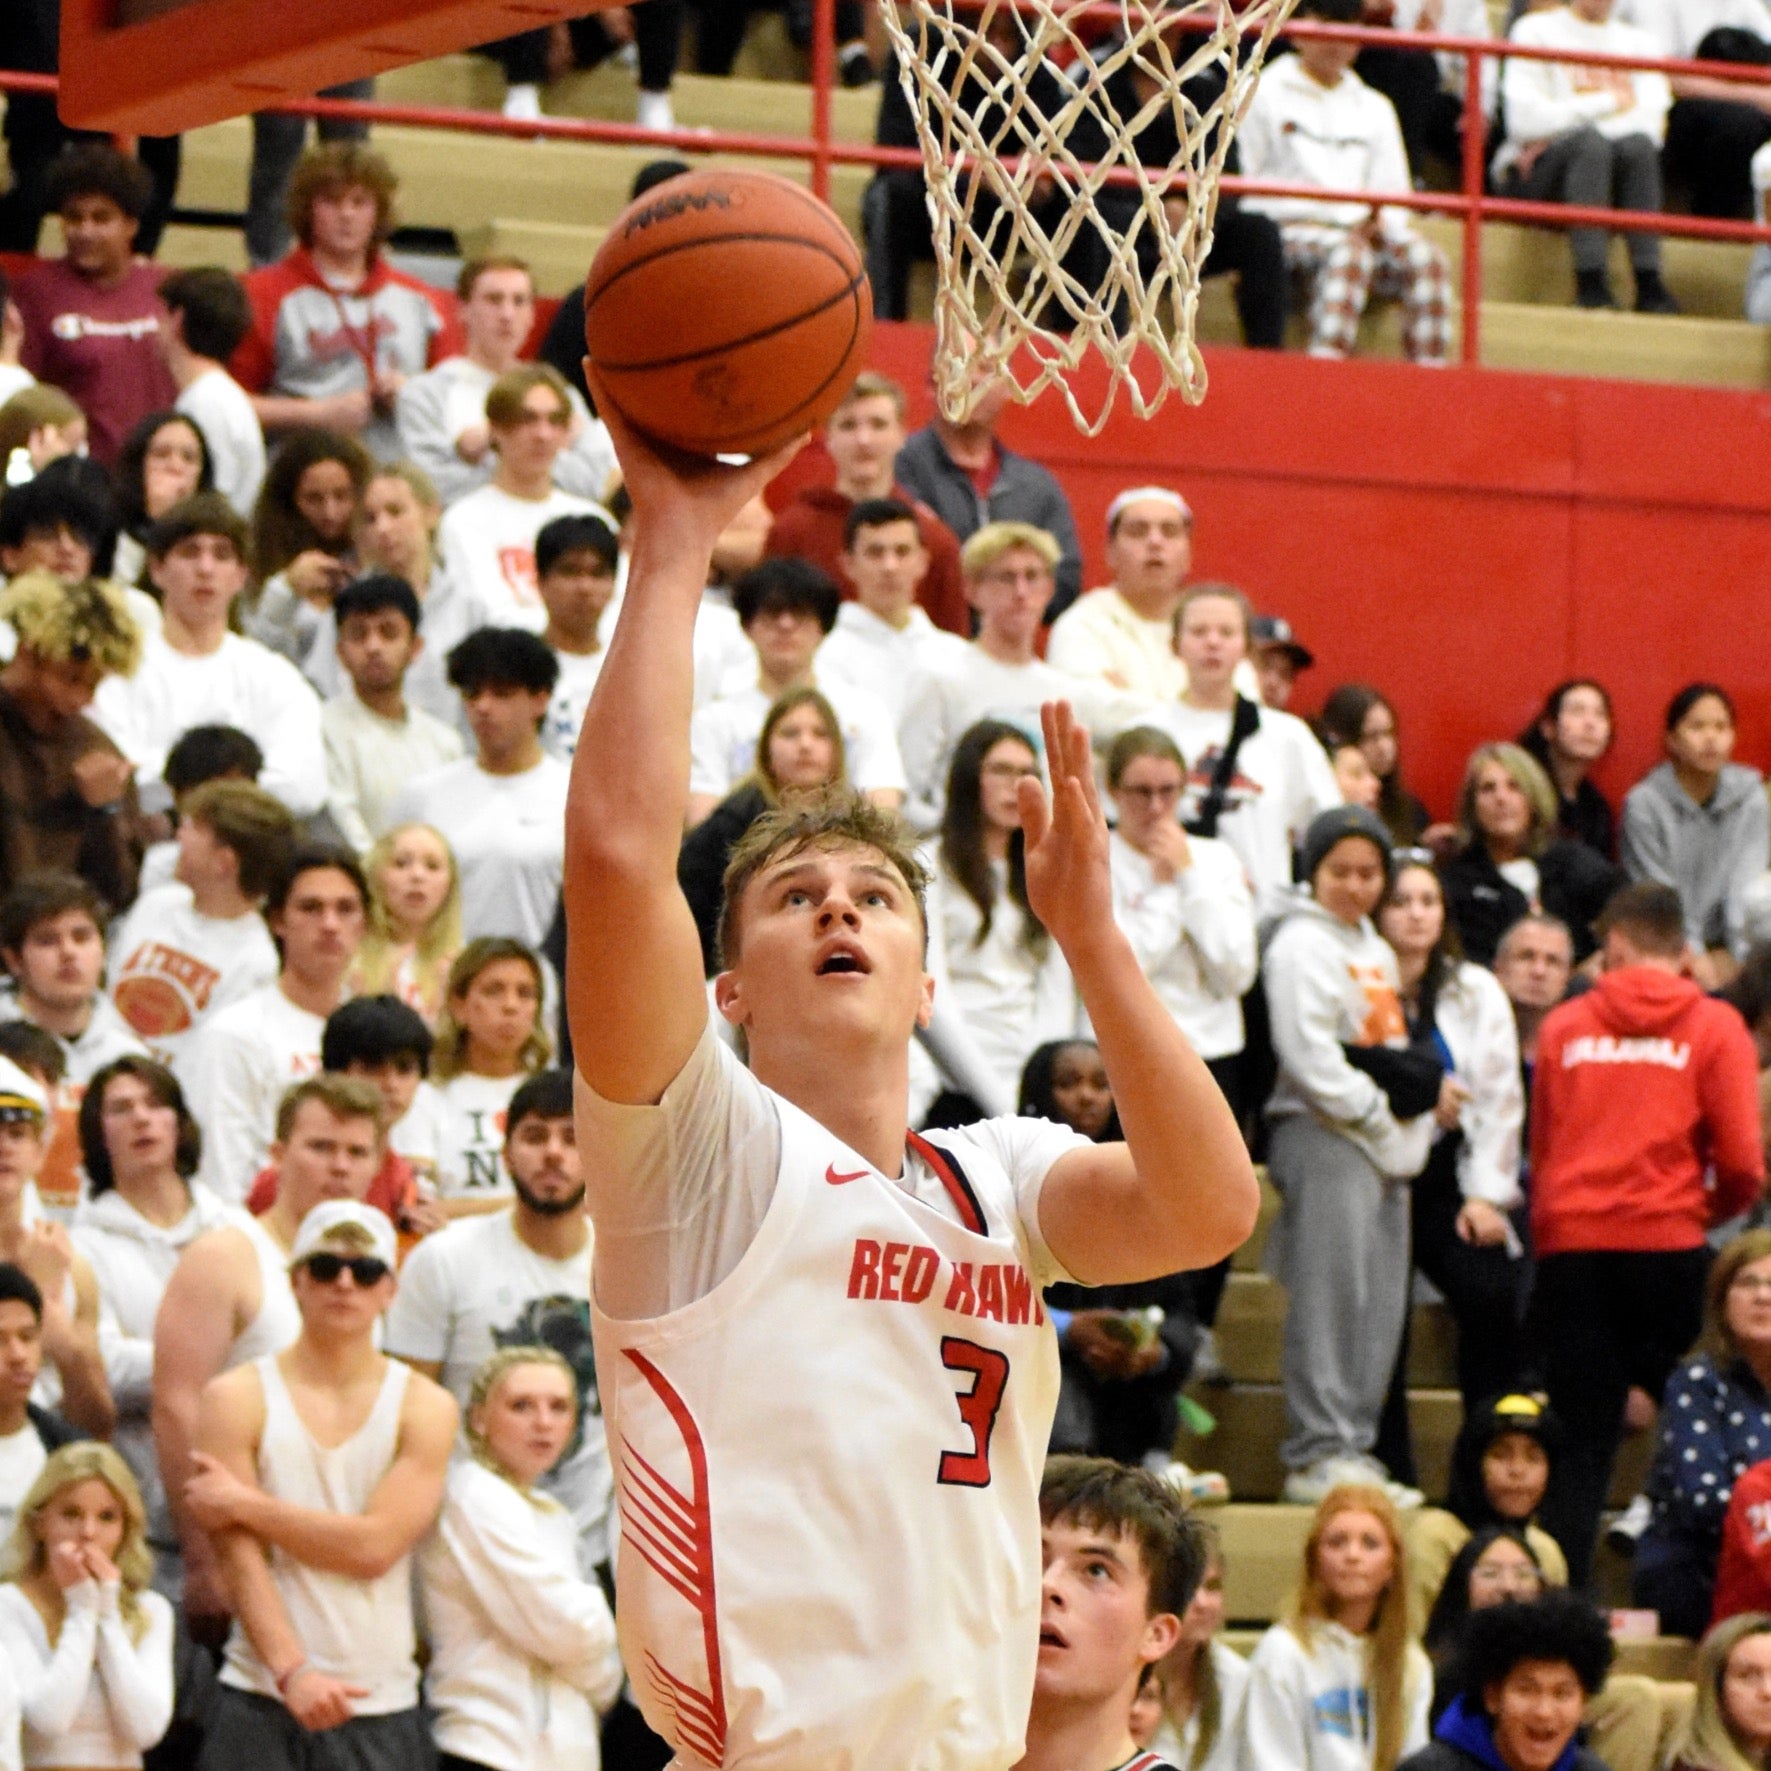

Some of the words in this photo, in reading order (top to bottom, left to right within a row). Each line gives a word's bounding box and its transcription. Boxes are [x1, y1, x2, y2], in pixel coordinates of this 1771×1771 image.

[467, 1109, 486, 1142] I
[847, 1238, 940, 1304] RED
[937, 1335, 1010, 1489] 3
